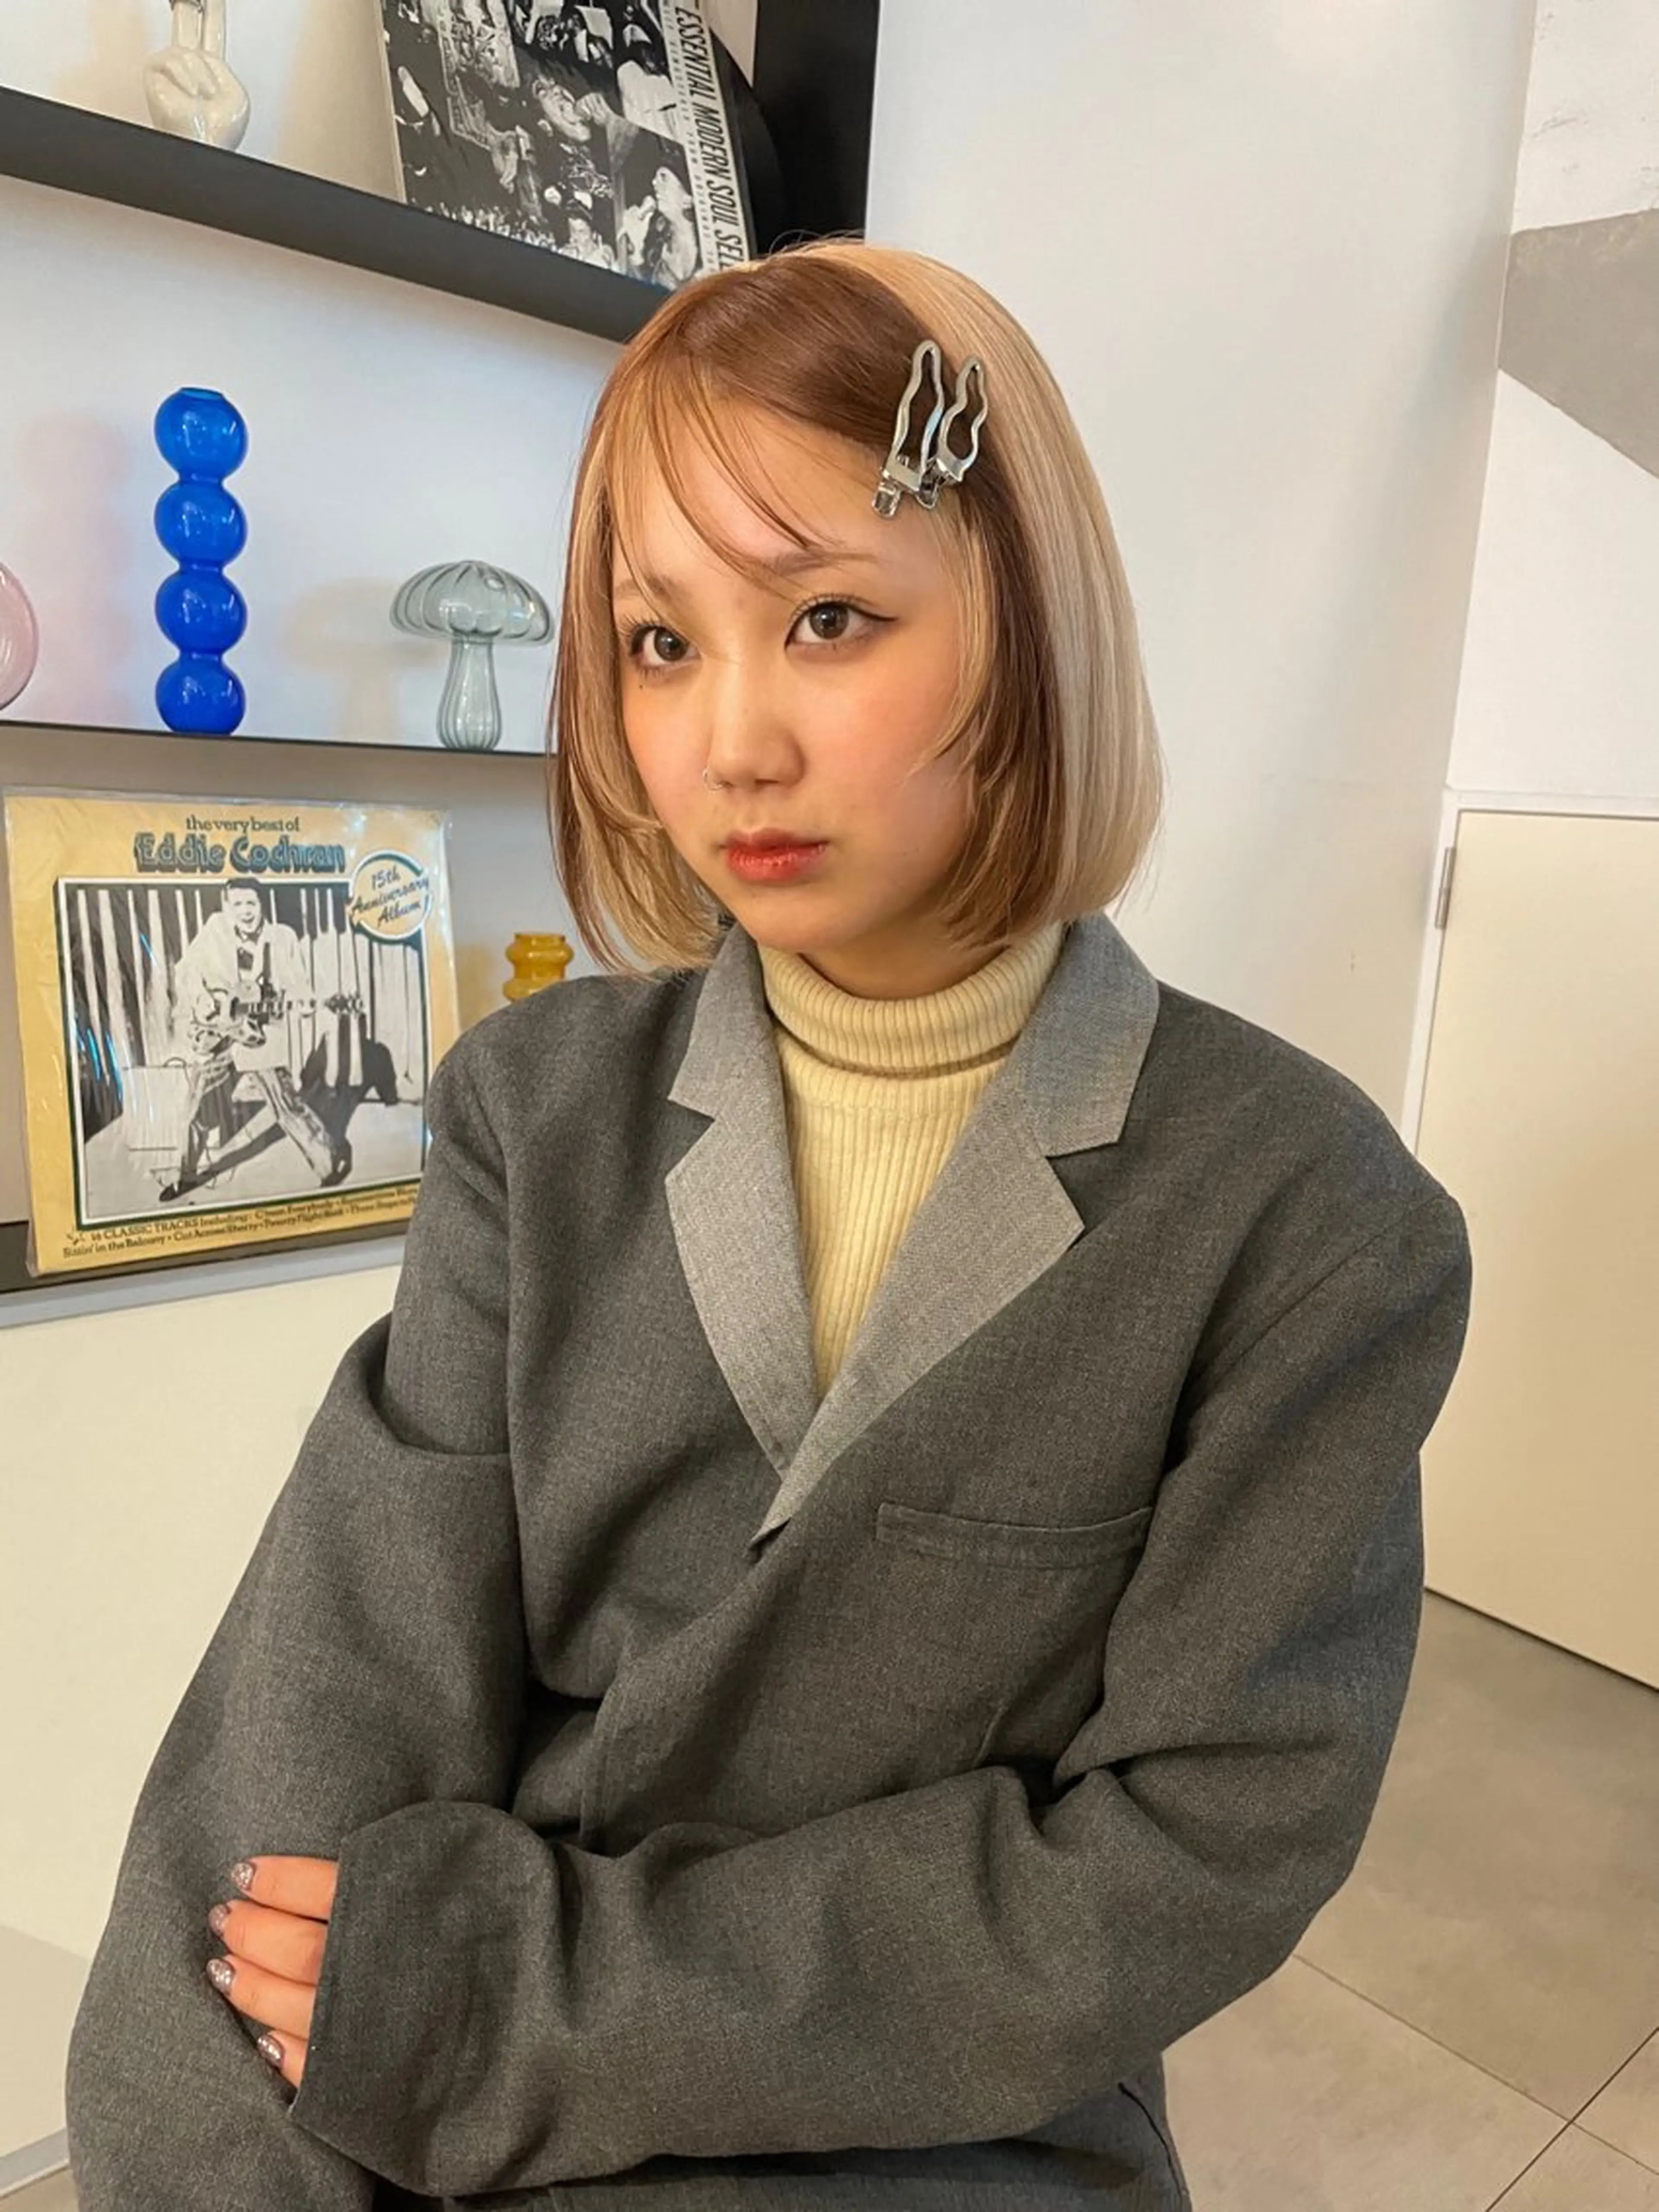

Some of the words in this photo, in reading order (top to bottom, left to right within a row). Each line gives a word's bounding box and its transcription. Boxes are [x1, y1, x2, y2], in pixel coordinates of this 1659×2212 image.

[675, 6, 717, 100] ESSENTIAL
[692, 102, 733, 181] MODERN
[706, 180, 740, 226] SOUL
[186, 814, 213, 830] the
[213, 820, 250, 833] very
[250, 815, 284, 832] best
[285, 815, 300, 832] of
[133, 832, 227, 873] Eddie
[229, 833, 347, 874] Cochran
[371, 864, 401, 892] 15th
[102, 1224, 154, 1240] CLASSIC
[154, 1217, 199, 1234] TRACKS
